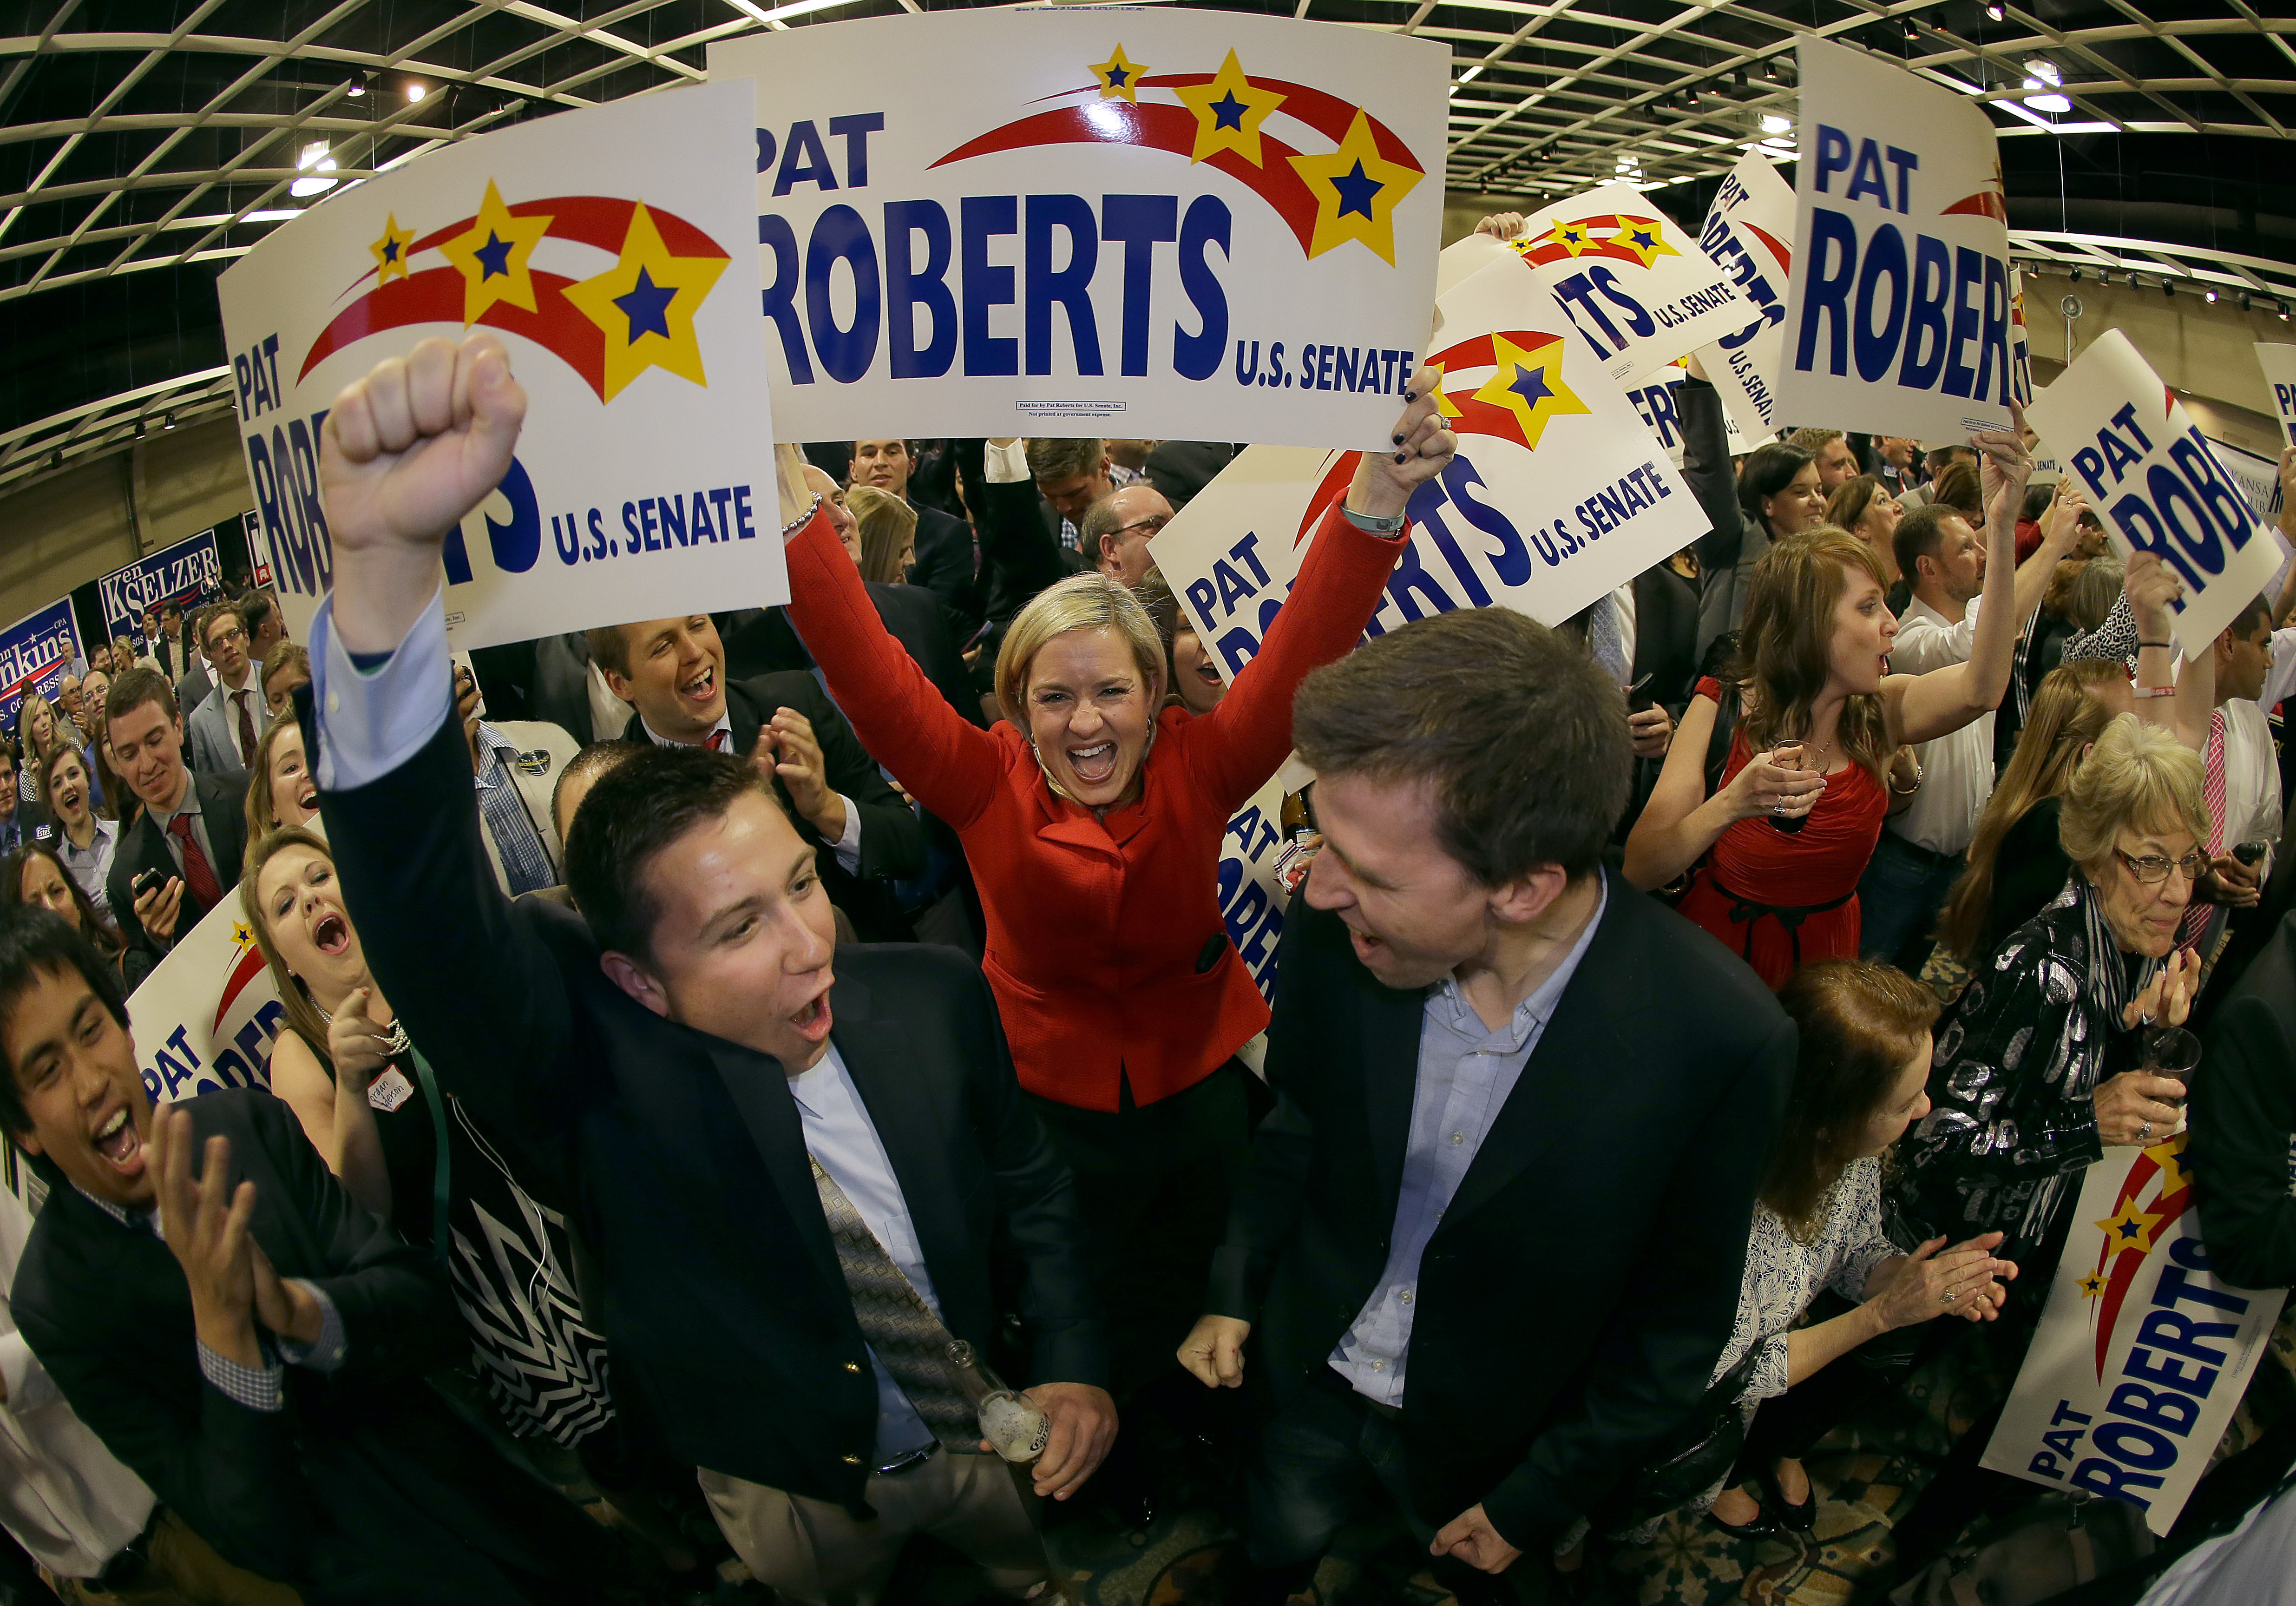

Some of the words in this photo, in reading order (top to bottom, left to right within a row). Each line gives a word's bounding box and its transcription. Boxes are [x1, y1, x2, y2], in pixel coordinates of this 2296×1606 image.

[1720, 174, 1750, 212] PAT
[1816, 124, 1918, 214] PAT
[759, 193, 1231, 384] ROBERTS
[1653, 305, 1689, 328] U.S.
[1680, 282, 1736, 317] SENATE
[1703, 211, 1785, 349] OBERTS
[1796, 207, 2010, 407] ROBER
[234, 332, 281, 421] PAT
[1236, 340, 1292, 388] U.S.
[1299, 343, 1414, 396] SENATE
[1728, 350, 1745, 379] U.S.
[1742, 375, 1773, 426] SENAT
[2071, 402, 2153, 501] PAT
[248, 408, 541, 597] ROBS
[551, 508, 618, 566] U.S.
[622, 485, 756, 554] SENATE
[1530, 519, 1586, 567] U.S.
[1575, 461, 1672, 540] SENATE
[200, 575, 220, 595] CA
[1185, 531, 1271, 632] PAT
[0, 628, 71, 691] nkins
[54, 618, 67, 630] CPA
[10, 674, 59, 714] CORESS
[37, 828, 51, 837] Estes
[1227, 804, 1279, 865] AT
[140, 1023, 201, 1103] PAT
[370, 1081, 388, 1101] organ
[2027, 1399, 2093, 1481] PAT
